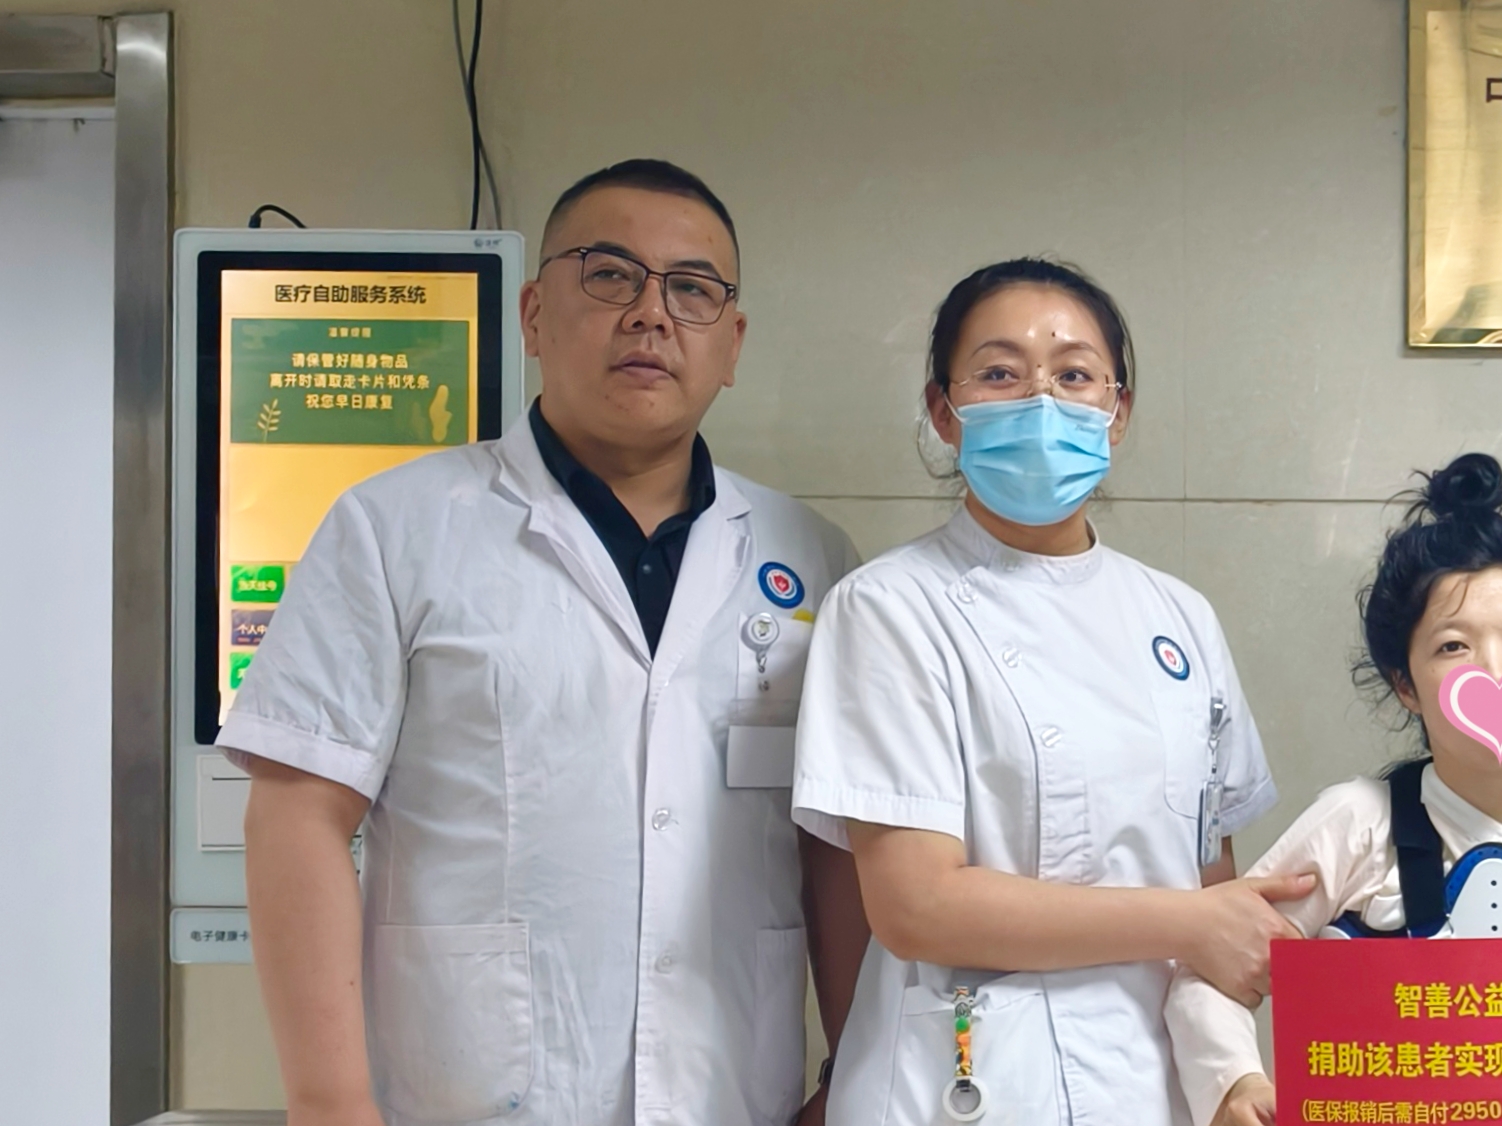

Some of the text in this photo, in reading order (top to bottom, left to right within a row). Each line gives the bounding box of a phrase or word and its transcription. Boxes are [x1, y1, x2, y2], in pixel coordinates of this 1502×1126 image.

[275, 284, 427, 304] 医疗自助服务系统
[292, 353, 408, 369] 请保管好随身物品
[270, 373, 430, 390] 离开时请取走卡片和凭条
[306, 394, 393, 411] 祝您早日康复
